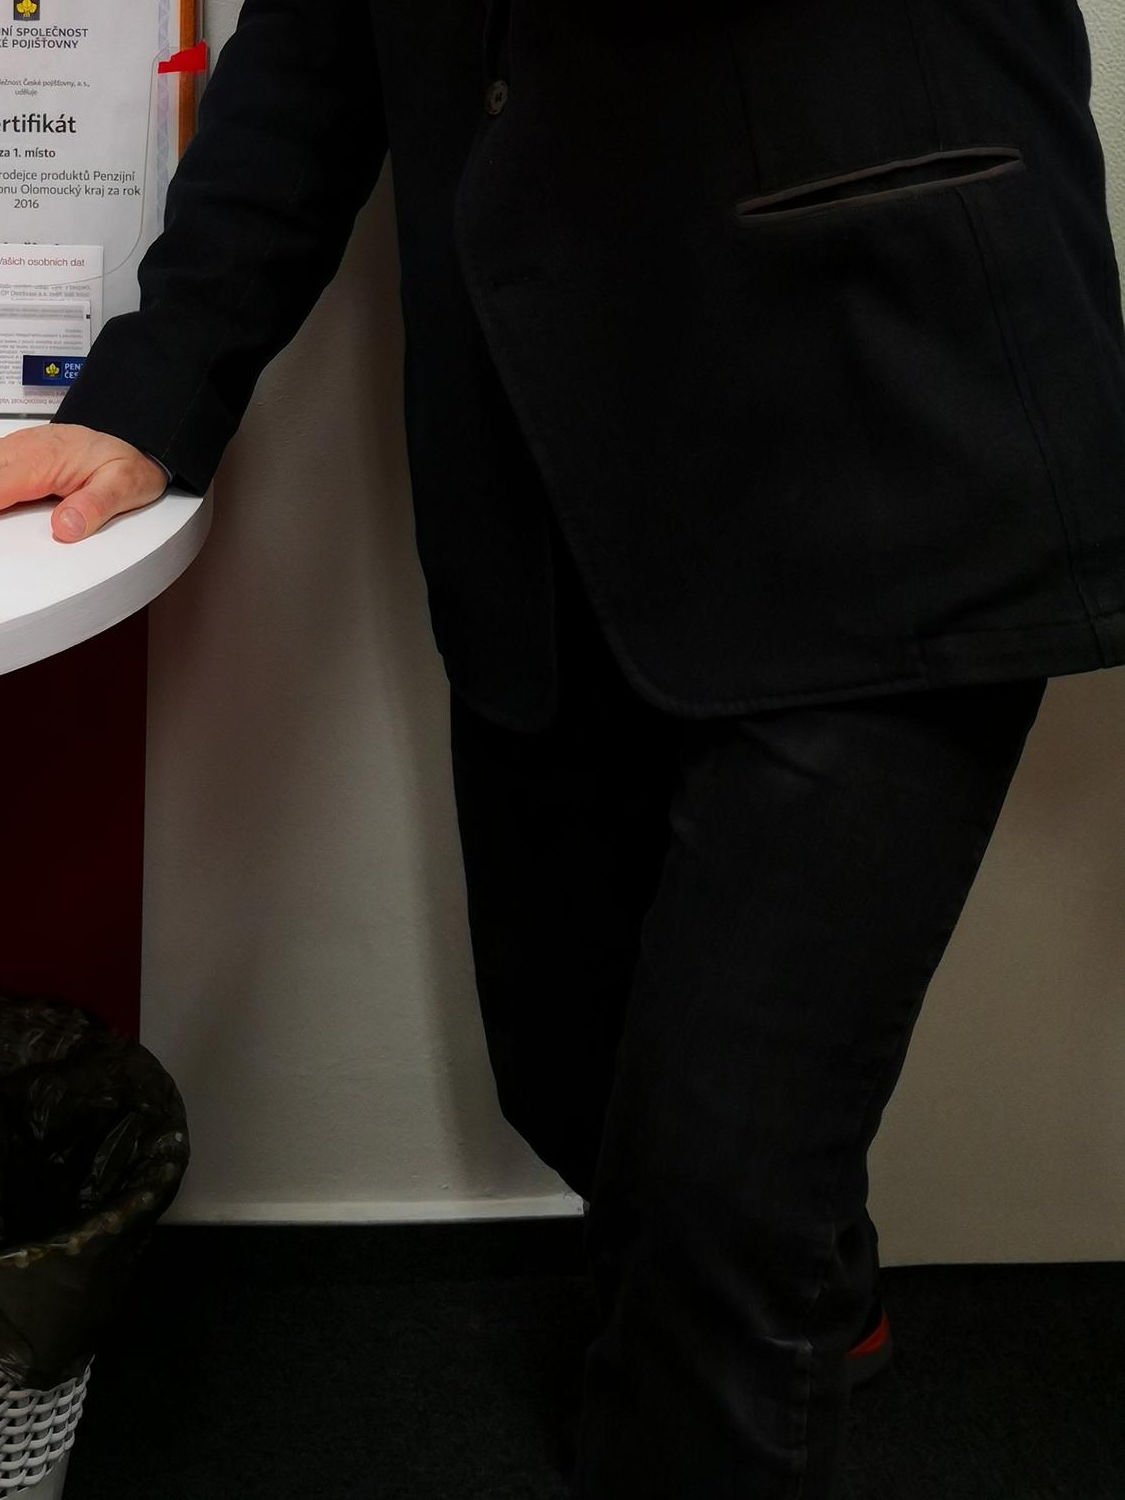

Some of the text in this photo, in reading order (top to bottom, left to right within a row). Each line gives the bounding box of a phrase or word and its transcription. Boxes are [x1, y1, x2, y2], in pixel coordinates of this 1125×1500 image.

[16, 25, 88, 38] SPOLEČNOST
[12, 37, 78, 49] POJIŠŤOVNY
[13, 148, 22, 158] 1.
[25, 147, 56, 158] místo
[40, 169, 90, 183] produktů
[93, 170, 135, 184] Penzijní
[21, 184, 81, 198] Olomoucký
[84, 185, 105, 199] kraj
[123, 186, 140, 196] rok
[14, 199, 39, 209] 2016
[28, 258, 68, 267] osobních
[71, 258, 84, 267] dat
